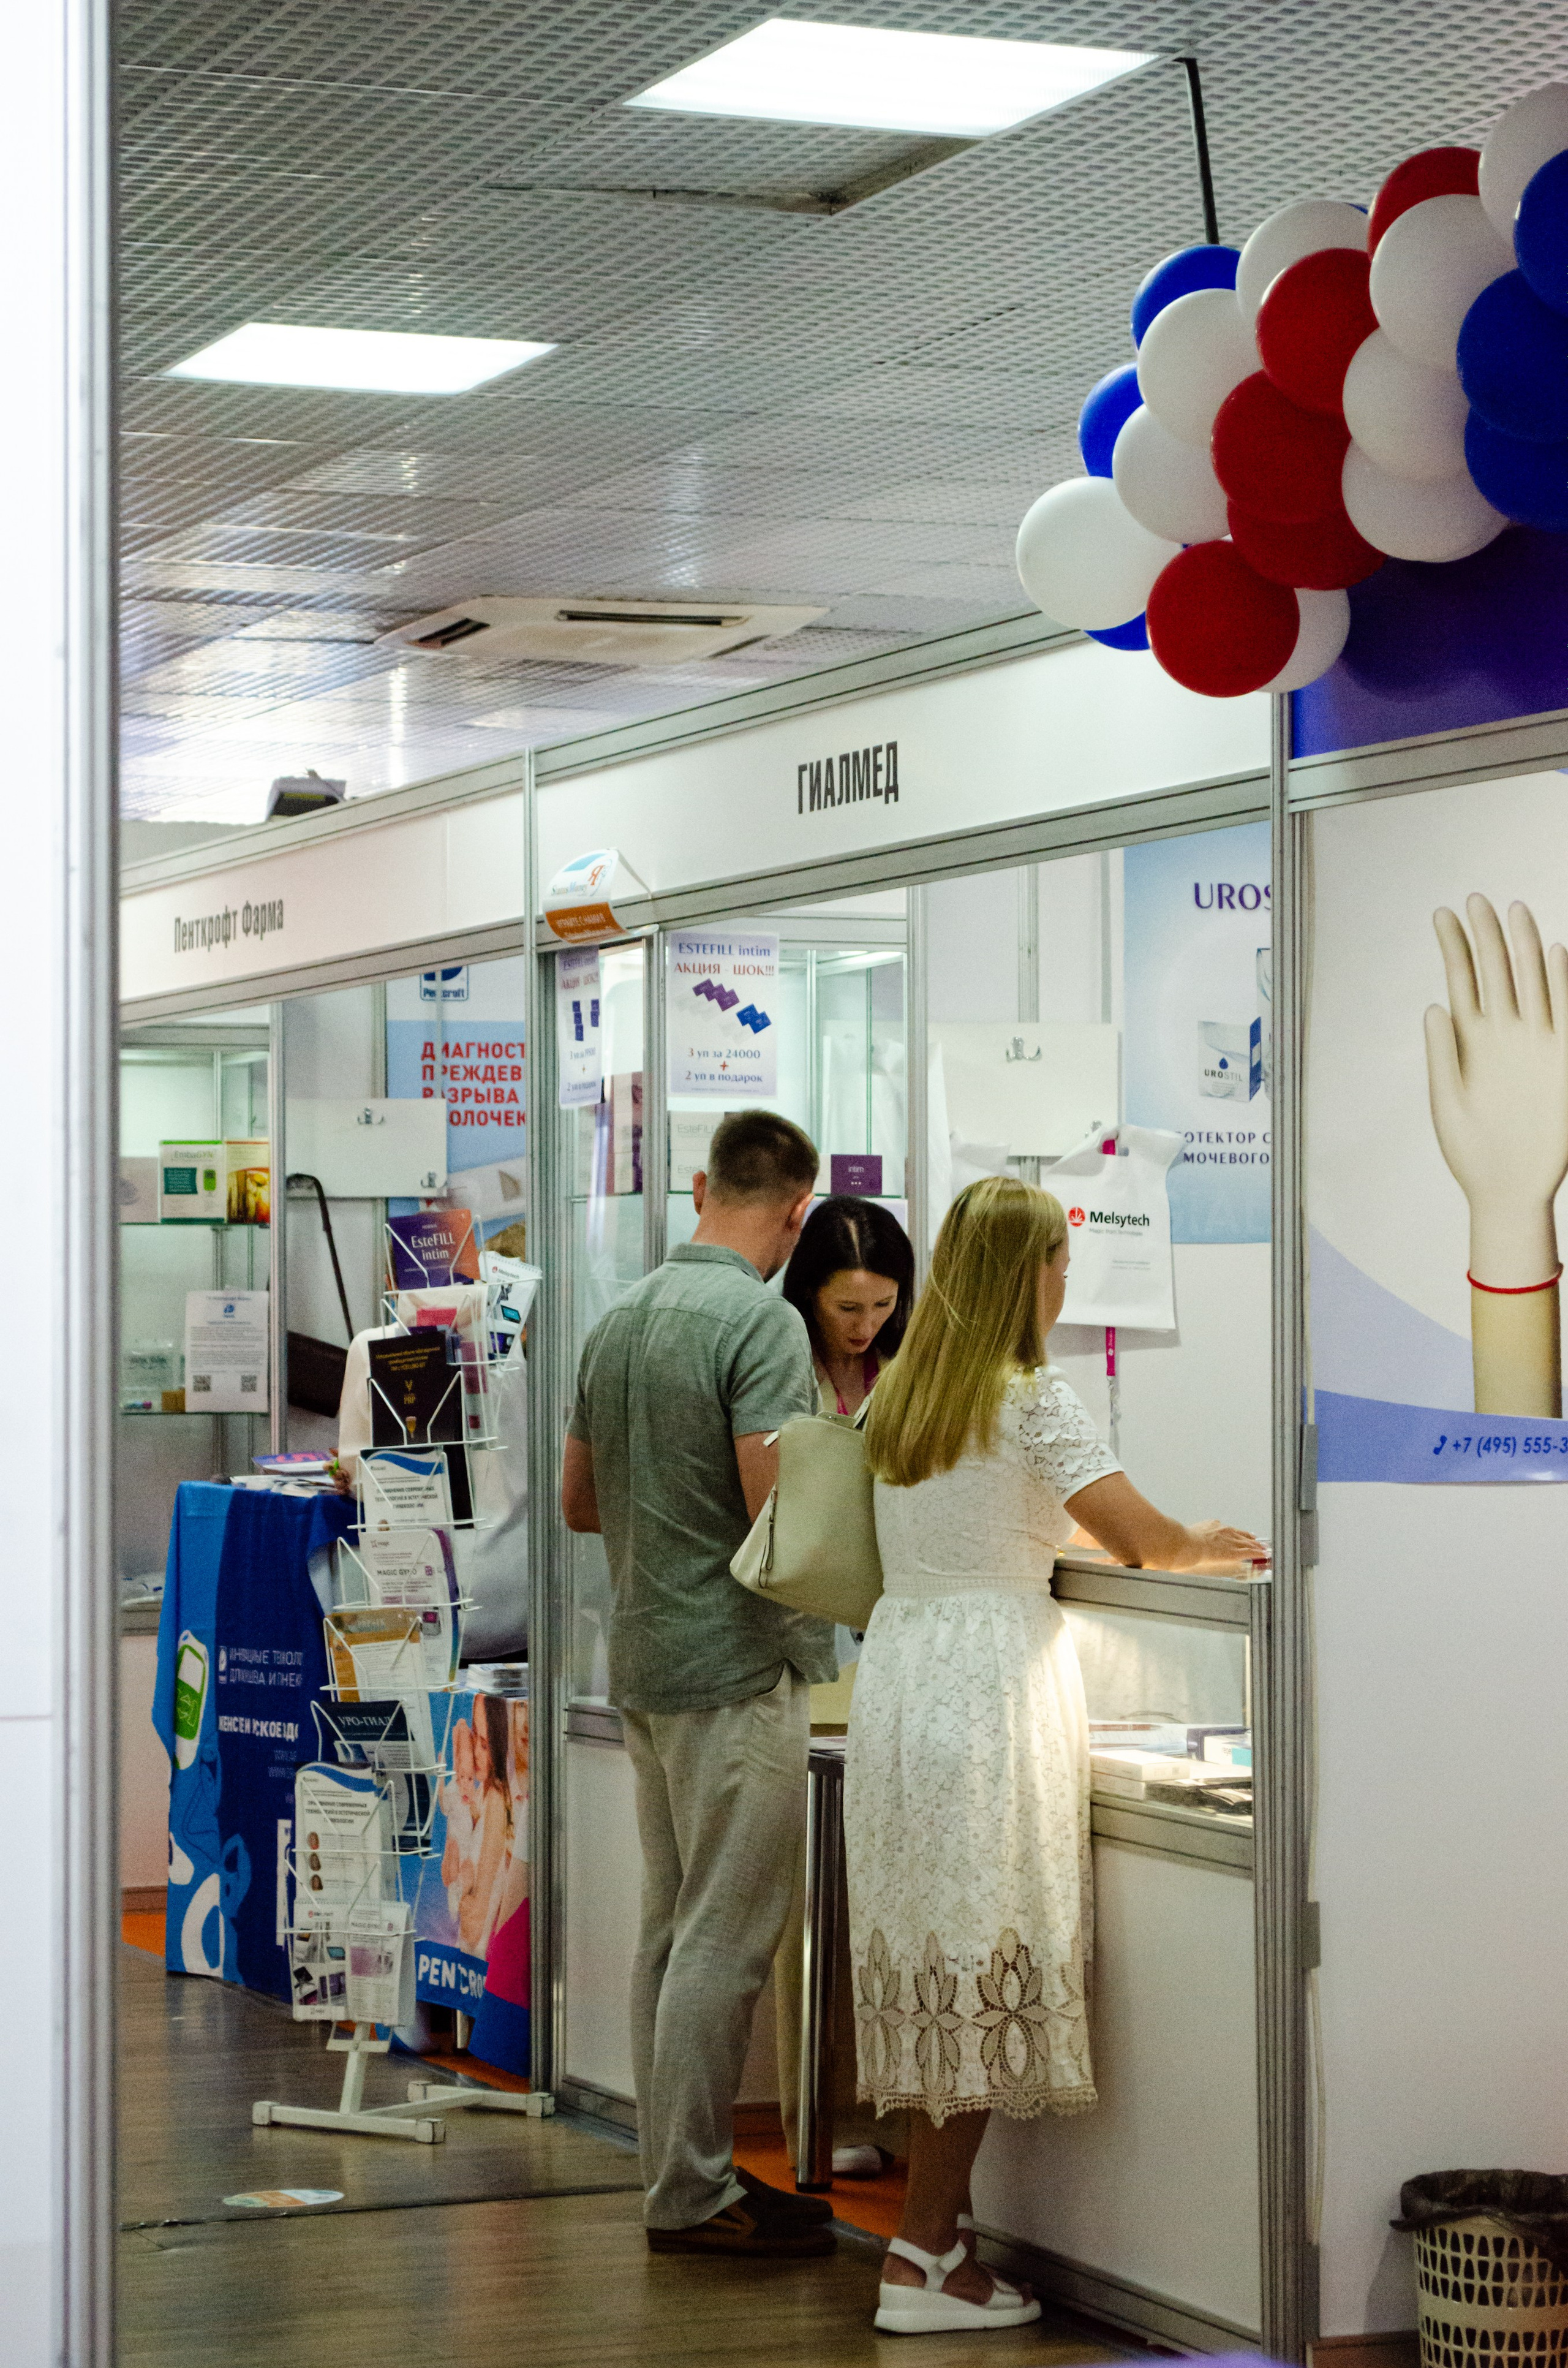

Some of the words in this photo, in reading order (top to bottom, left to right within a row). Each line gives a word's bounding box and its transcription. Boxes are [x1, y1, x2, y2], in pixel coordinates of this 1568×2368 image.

[798, 741, 899, 814] ГИАЛМЕД
[175, 905, 238, 953] Пенткрофт
[242, 899, 284, 940] Фарма
[679, 942, 734, 955] ESTEFILL
[739, 945, 771, 956] intim
[674, 962, 720, 975] АКЦИЯ
[733, 964, 774, 976] ШОК!!!
[688, 1048, 694, 1057] 3
[697, 1050, 709, 1059] уп
[725, 1049, 761, 1059] 24000
[685, 1071, 691, 1080] 2
[718, 1074, 763, 1083] подарок
[1204, 1069, 1243, 1082] UROSTIL
[1176, 1132, 1256, 1144] ОТЕКТОР
[1090, 1211, 1150, 1228] Melsytech
[411, 1232, 455, 1248] EsteFILL
[421, 1249, 450, 1261] intim
[1453, 1437, 1472, 1453] +7
[1477, 1436, 1517, 1458] (495)
[1523, 1437, 1568, 1454] 555-3
